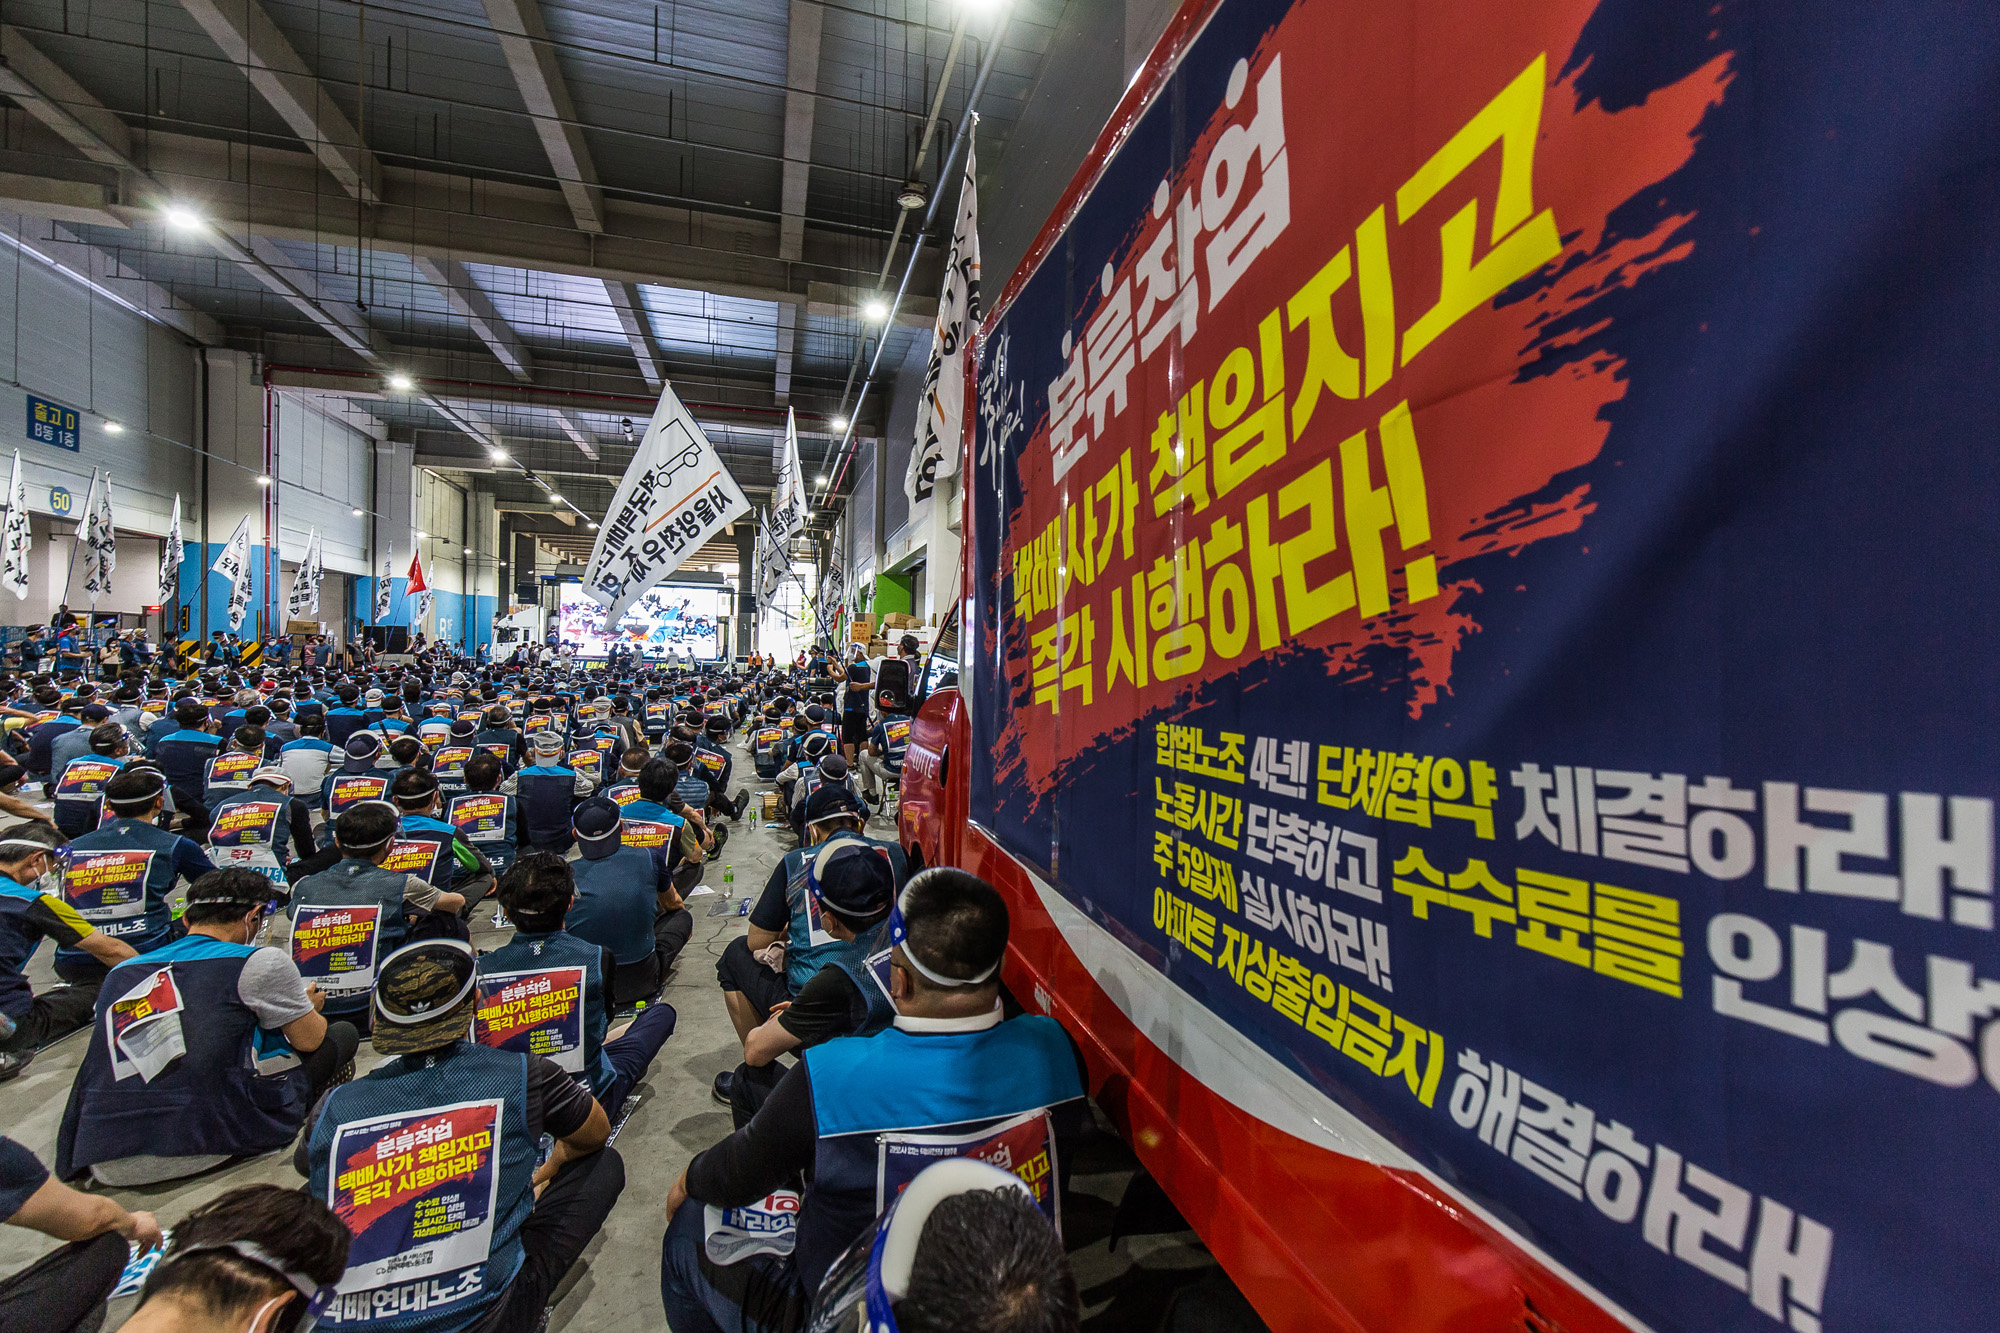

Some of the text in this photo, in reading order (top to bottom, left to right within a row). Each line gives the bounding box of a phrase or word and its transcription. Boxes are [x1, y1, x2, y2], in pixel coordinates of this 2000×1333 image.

[1048, 52, 1291, 486] 분류작업
[1013, 447, 1139, 622] 택배사가
[1149, 51, 1563, 518] 책임지고
[35, 402, 61, 426] 출고
[53, 491, 70, 511] 50
[1031, 604, 1095, 715] 즉각
[1107, 400, 1439, 694] 시행하라!
[1155, 721, 1994, 930] 합법노조 4년! 단체협약 체결하라!
[231, 849, 253, 860] 즉각
[1153, 830, 1393, 993] 주 5일제 실시하라!
[1155, 776, 2000, 1094] 노동시간 단축하고 수수료를 인상
[477, 986, 579, 1020] 택배사가 책임지고
[488, 1001, 570, 1031] 즉각 시행하라!
[501, 977, 551, 1002] 분류작업
[1153, 887, 1834, 1333] 아파트 지상출입금지 해결하라!
[338, 1130, 491, 1191] 택배사가 책임지고
[376, 1118, 453, 1160] 분류작업
[354, 1153, 478, 1206] 즉각 시행하라!
